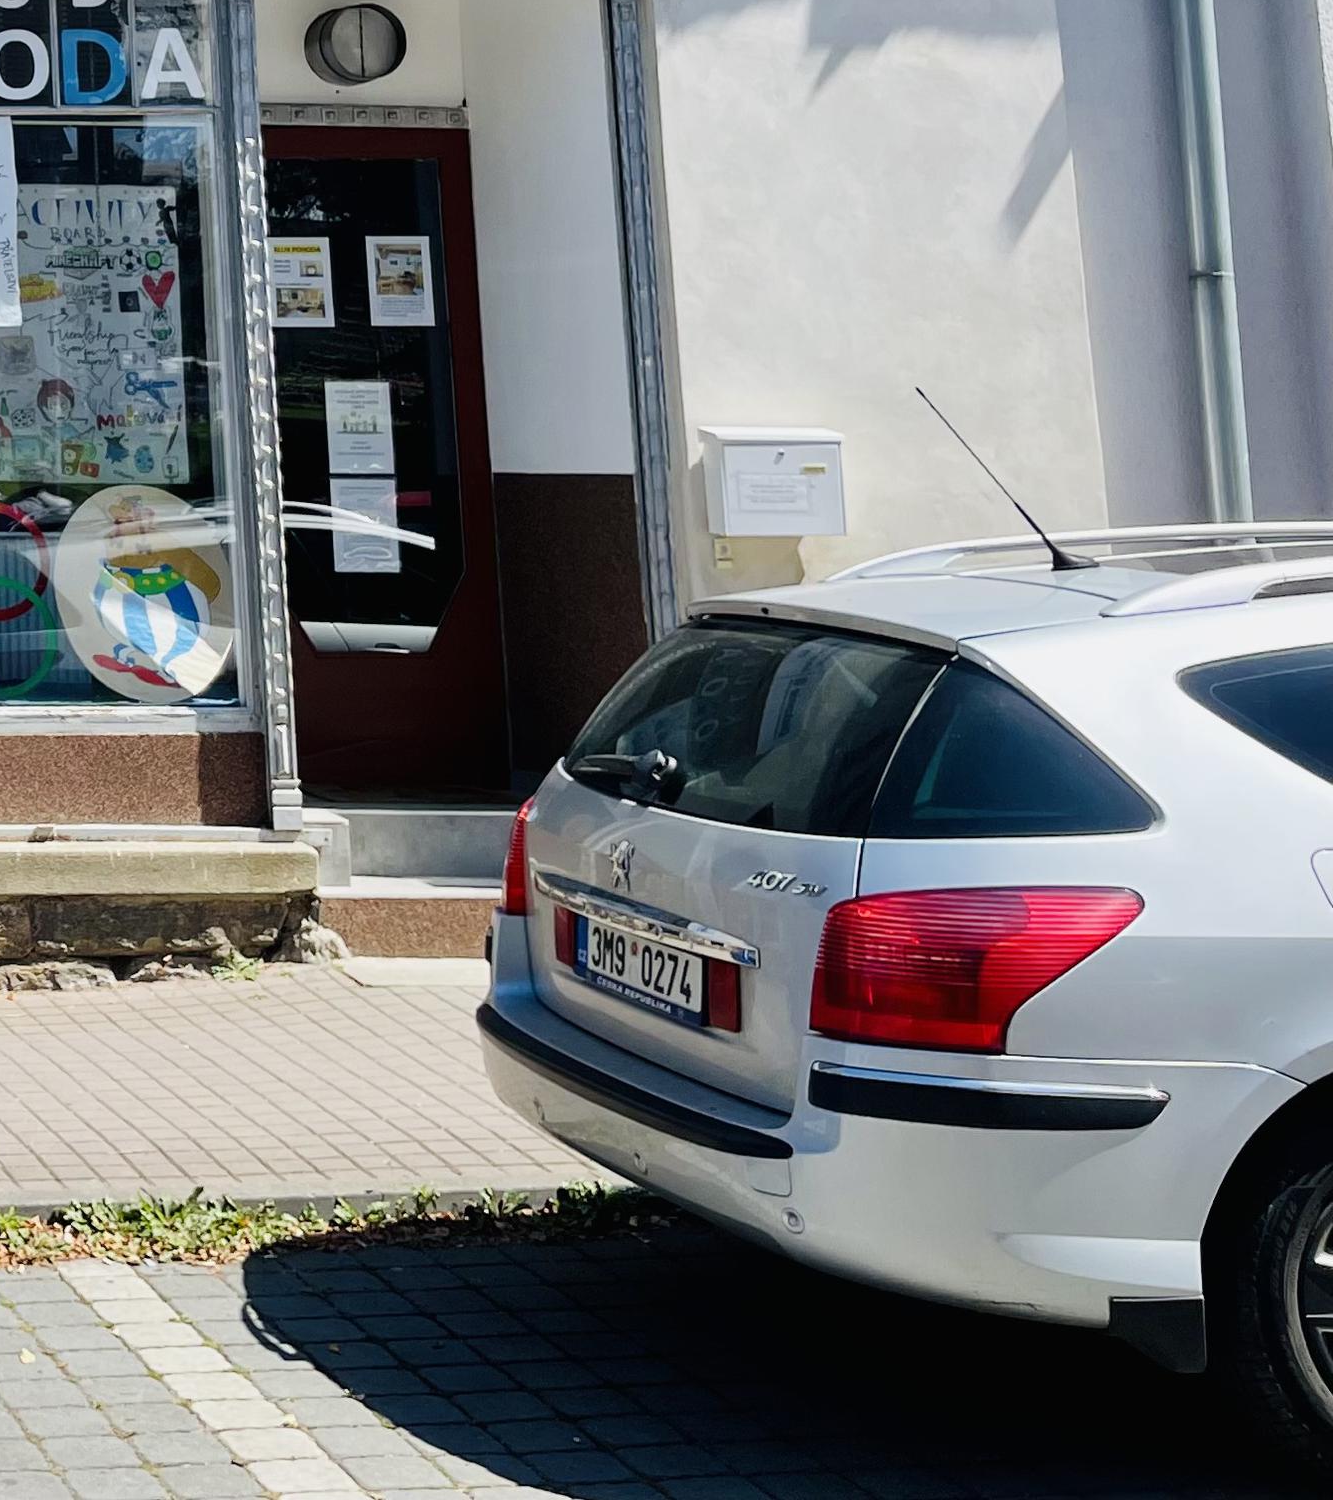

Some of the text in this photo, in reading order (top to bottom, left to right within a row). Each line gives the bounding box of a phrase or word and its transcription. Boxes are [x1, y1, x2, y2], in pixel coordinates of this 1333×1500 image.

[746, 869, 797, 892] 407
[591, 926, 692, 1004] 3M9 0274
